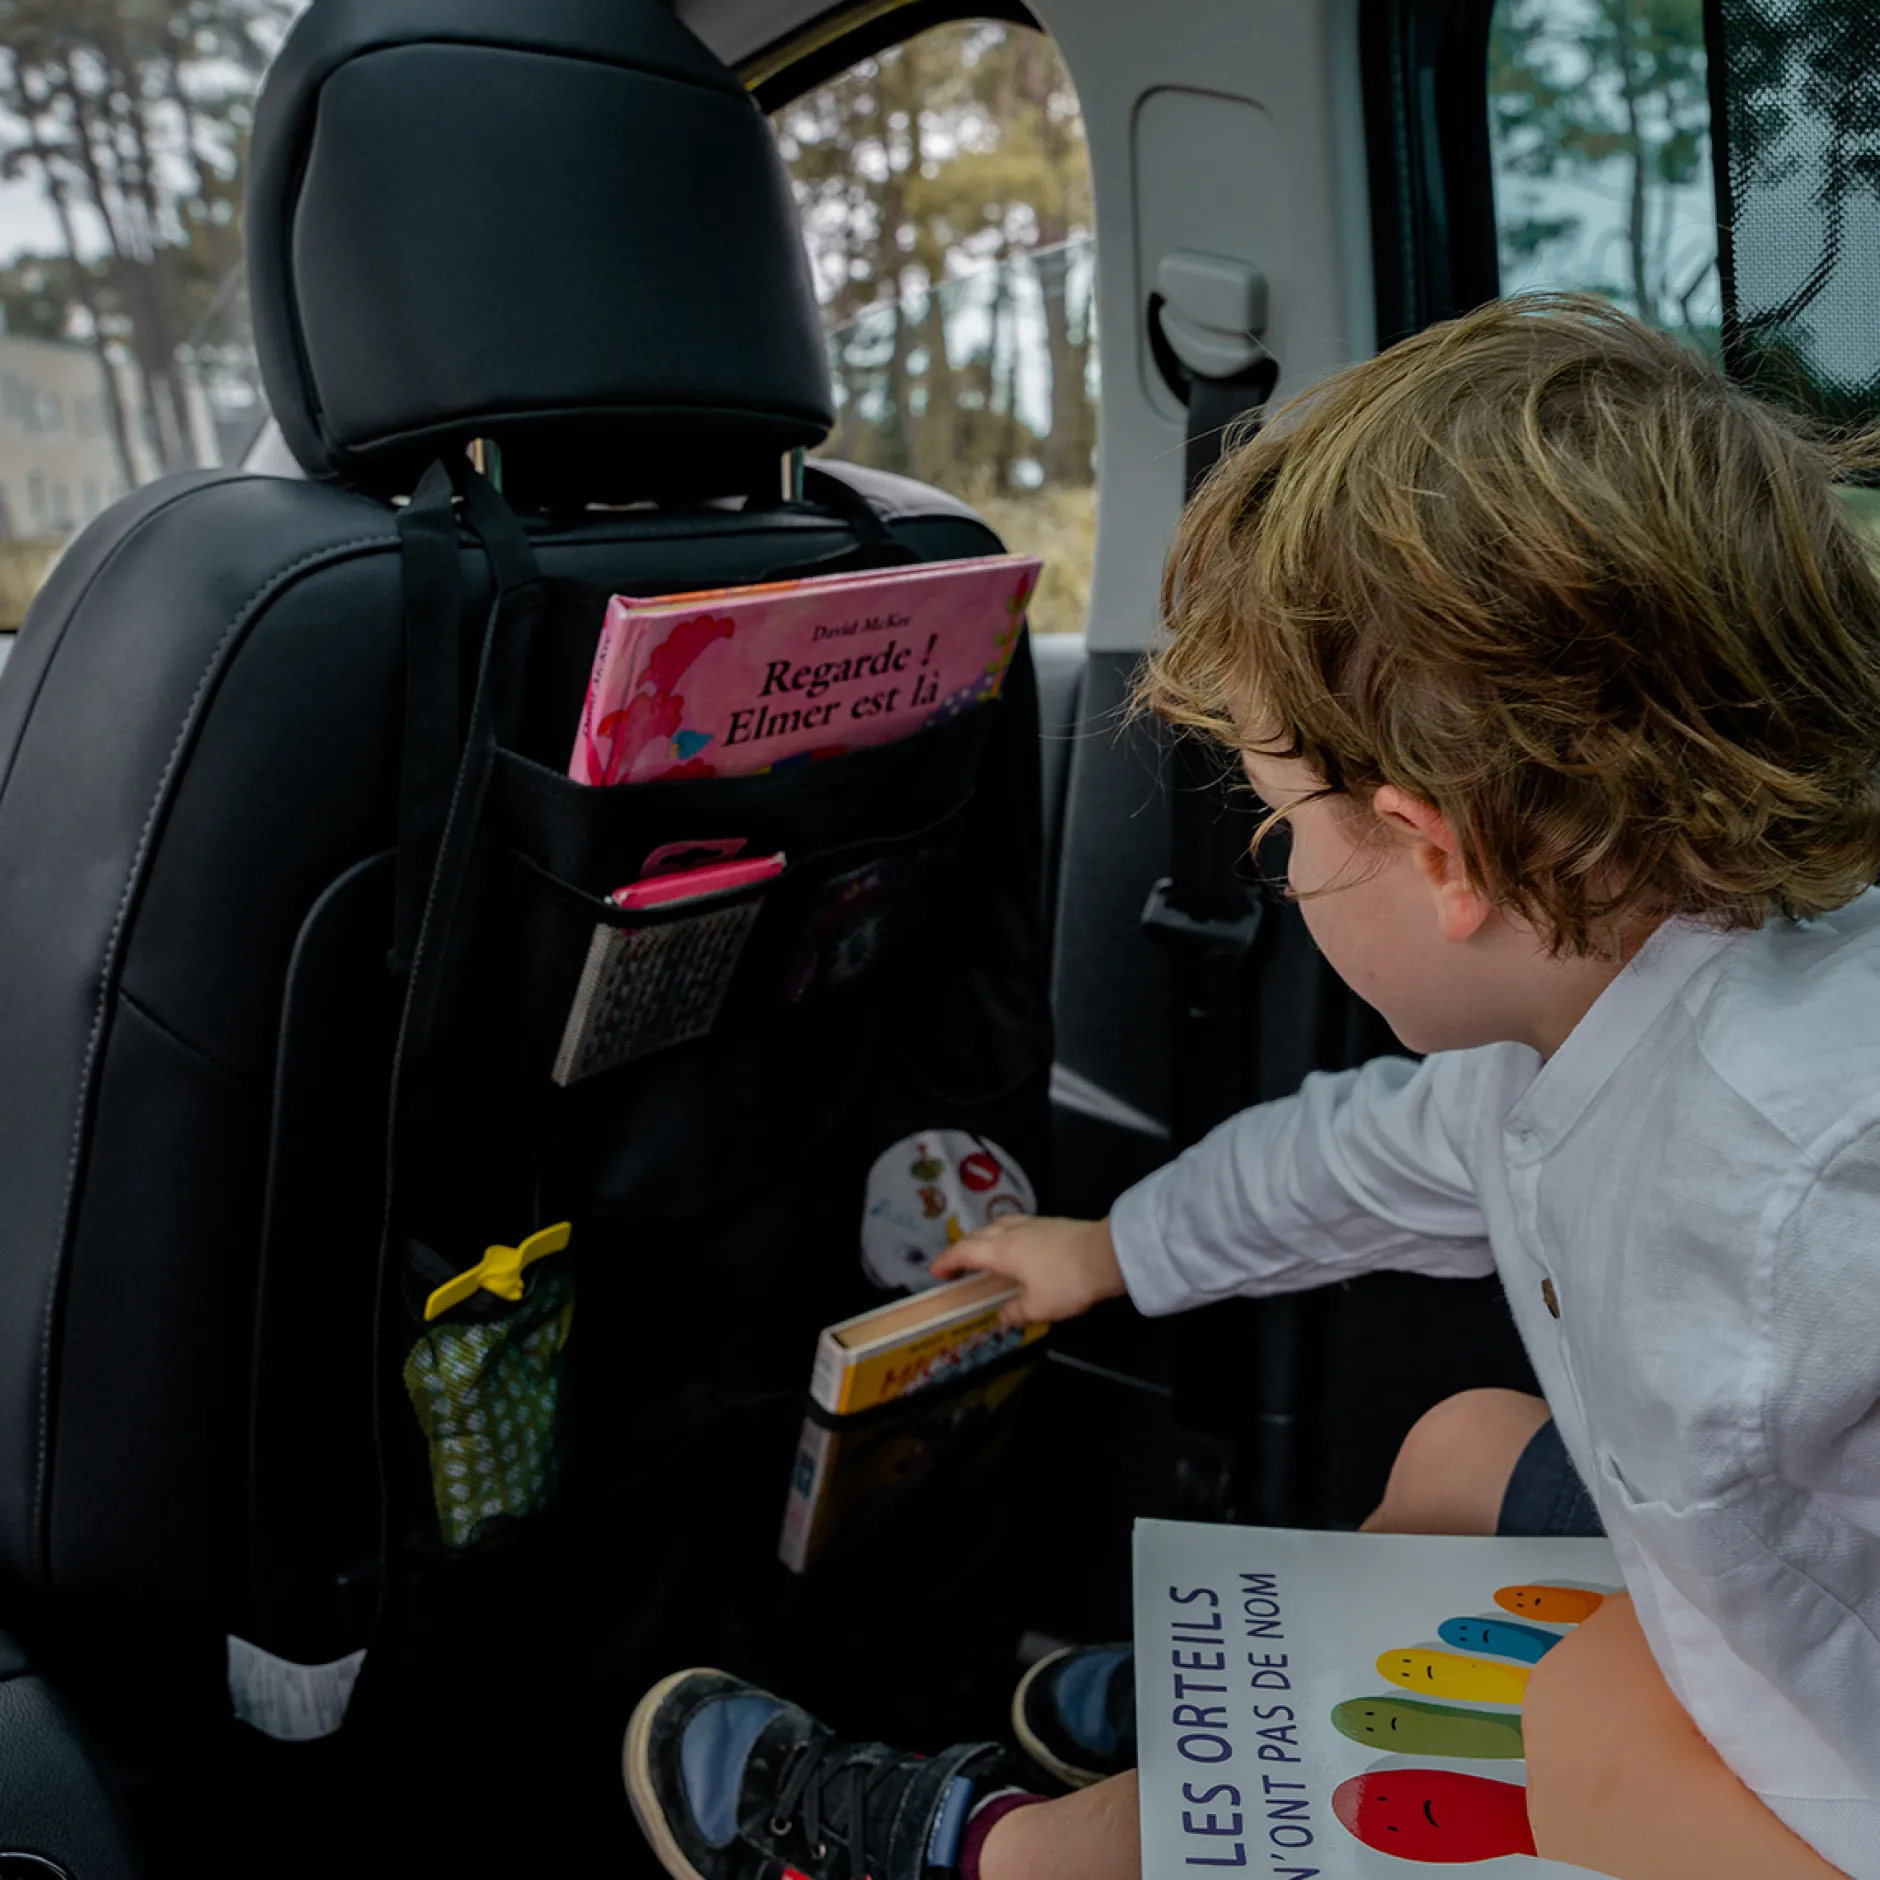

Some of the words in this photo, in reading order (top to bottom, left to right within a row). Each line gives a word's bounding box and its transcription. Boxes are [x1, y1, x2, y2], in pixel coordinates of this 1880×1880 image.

[812, 620, 858, 641] David
[758, 640, 912, 698] Regarde
[921, 633, 939, 666] !
[721, 705, 841, 747] Elmer
[851, 687, 902, 720] est
[910, 670, 941, 708] là
[1239, 1573, 1284, 1639] NOM
[1168, 1585, 1233, 1764] ORTEILS
[1248, 1652, 1292, 1690] DE
[1253, 1704, 1301, 1763] PAS
[1182, 1782, 1247, 1866] LES
[1262, 1774, 1320, 1880] N'ONT
